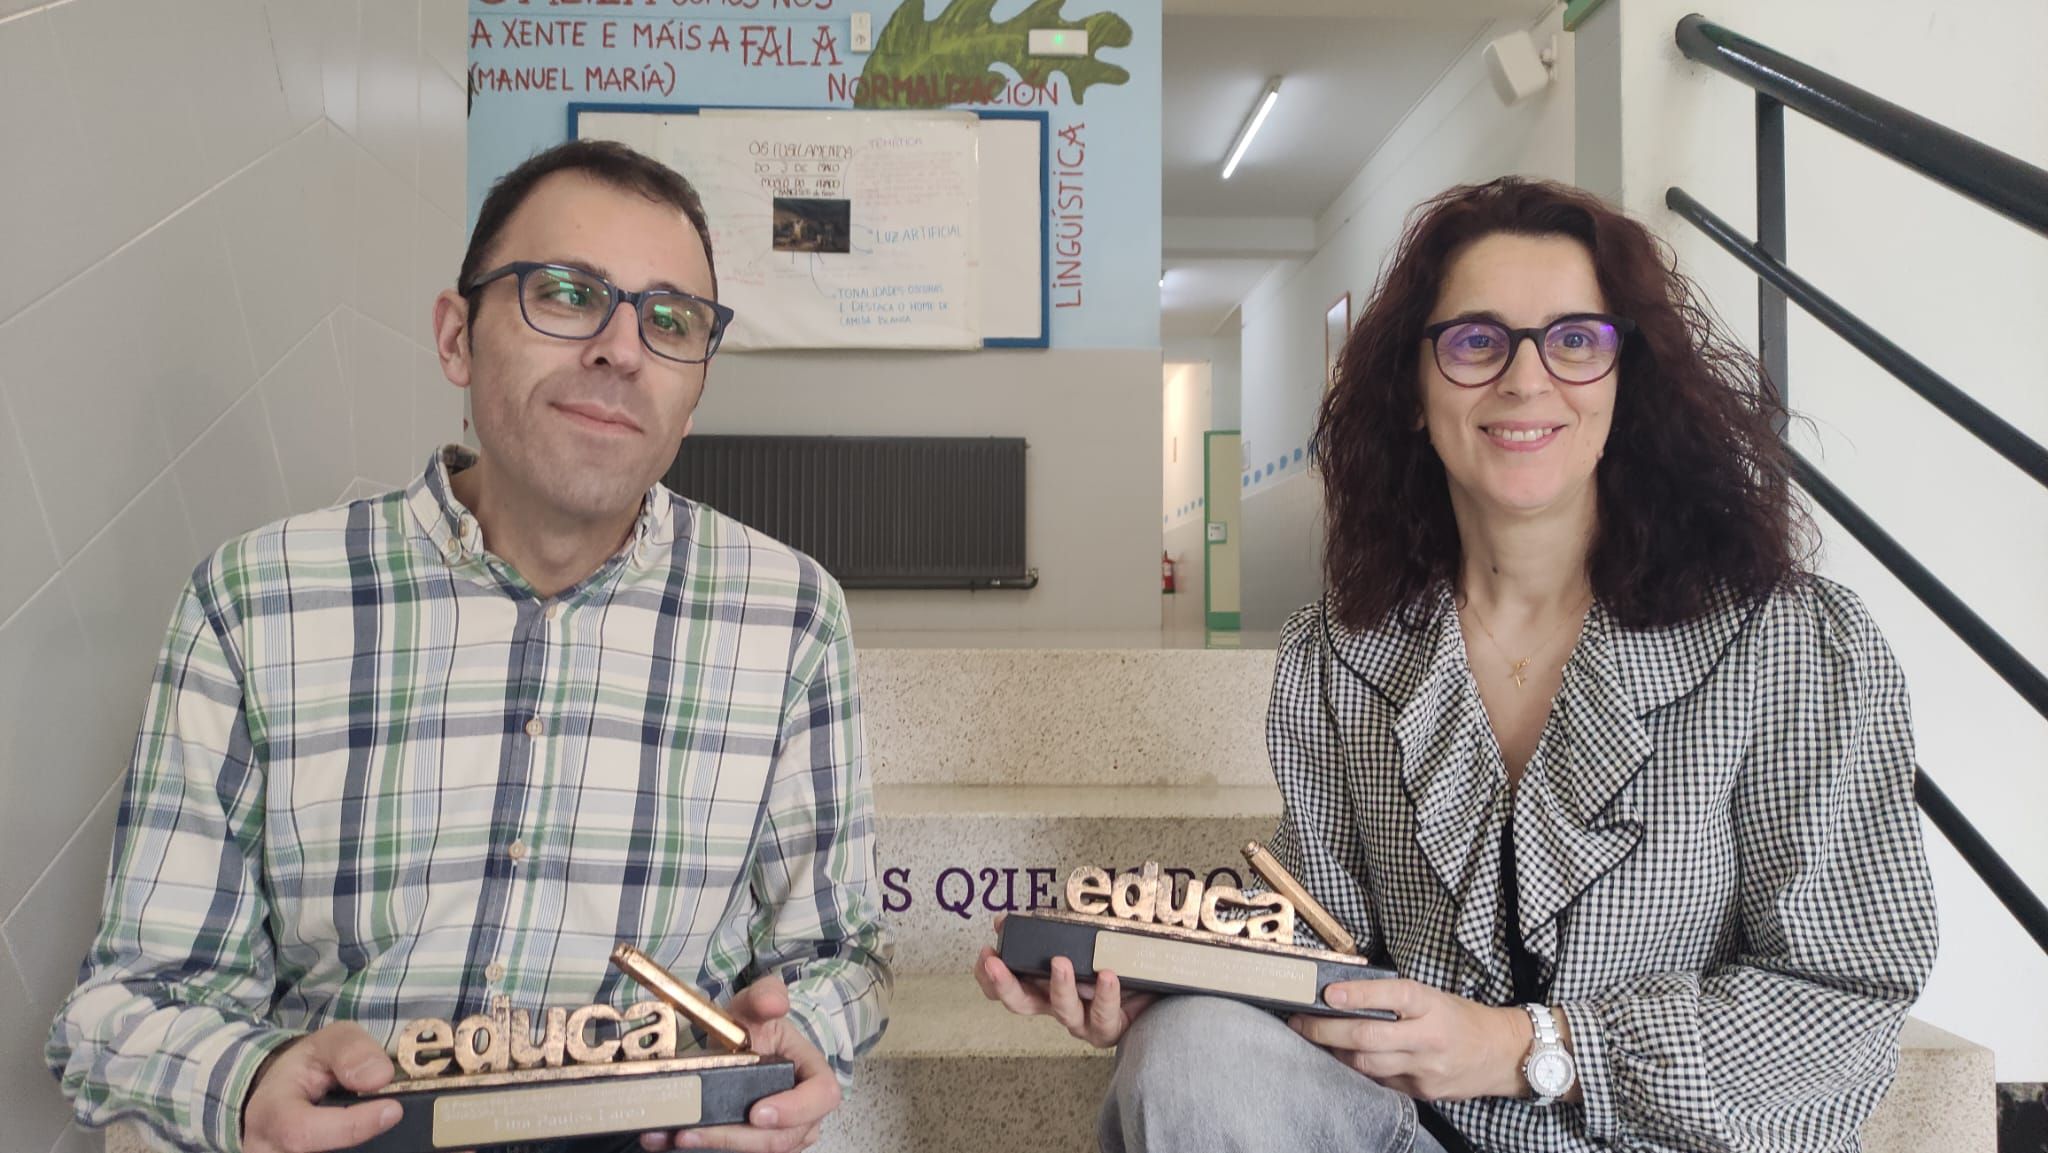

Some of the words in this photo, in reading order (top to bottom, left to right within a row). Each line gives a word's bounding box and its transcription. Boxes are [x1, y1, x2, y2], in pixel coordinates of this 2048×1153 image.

[470, 18, 493, 48] A
[502, 18, 587, 48] XENTE
[602, 22, 617, 48] E
[708, 25, 730, 52] A
[740, 25, 843, 67] FALA
[470, 62, 574, 96] (MANUEL
[585, 61, 676, 97] MARÍA)
[876, 229, 899, 243] LUZ
[902, 225, 961, 241] ARTIFICIAL
[935, 866, 1057, 918] QUE
[1066, 861, 1294, 944] educa
[398, 994, 677, 1079] educa
